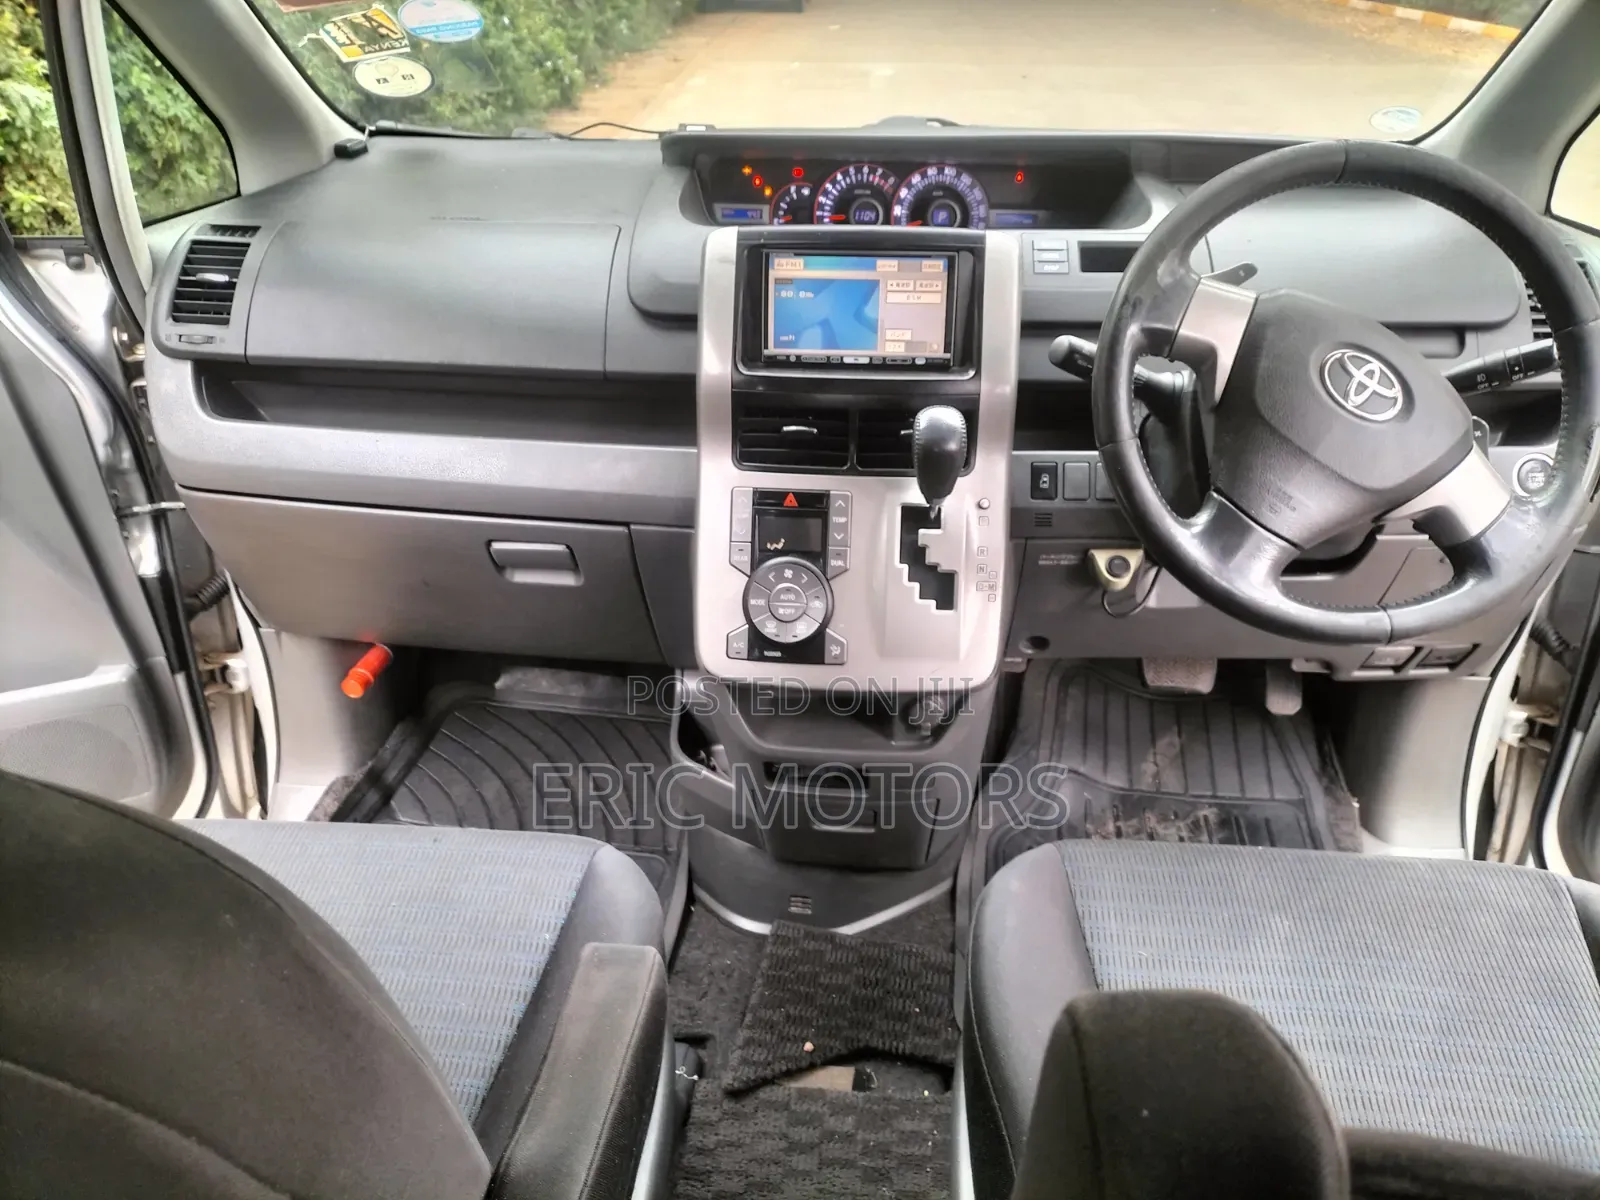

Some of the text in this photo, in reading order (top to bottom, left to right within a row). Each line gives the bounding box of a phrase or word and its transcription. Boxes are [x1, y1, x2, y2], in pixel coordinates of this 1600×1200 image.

[938, 211, 947, 223] P
[1511, 373, 1524, 381] OFF
[830, 559, 845, 567] DUAL
[780, 593, 796, 601] AUTO
